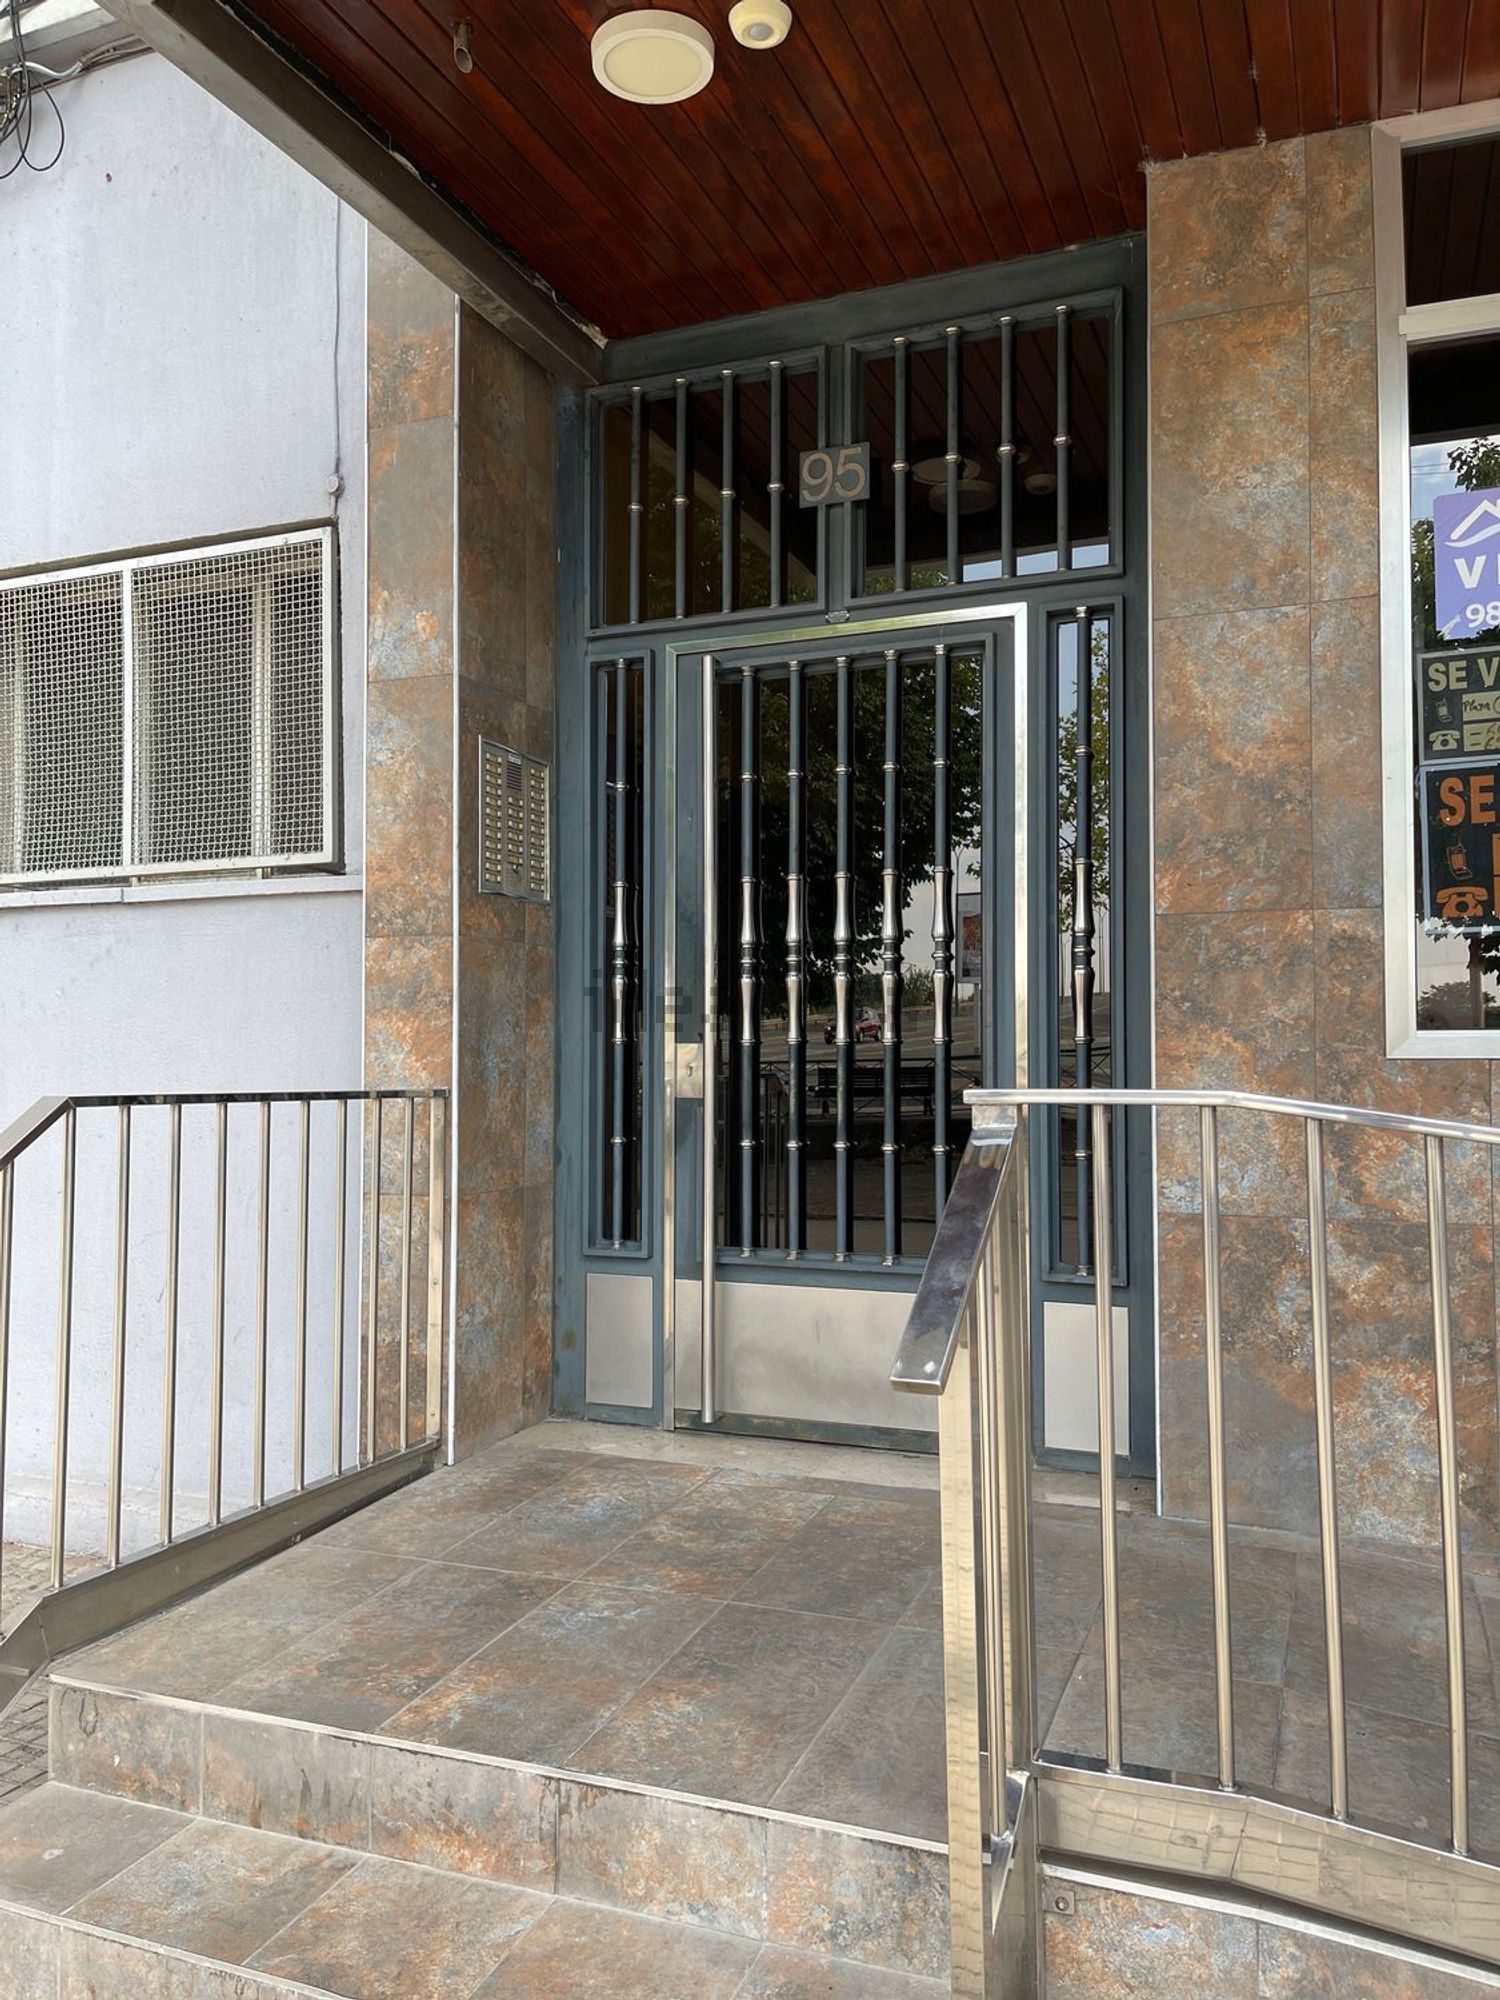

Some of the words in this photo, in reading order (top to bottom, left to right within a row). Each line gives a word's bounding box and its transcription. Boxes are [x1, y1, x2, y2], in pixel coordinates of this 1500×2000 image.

[802, 446, 866, 501] 95
[1453, 553, 1500, 589] V
[1465, 601, 1500, 628] 98
[1428, 660, 1468, 692] SE
[1440, 774, 1496, 827] SE
